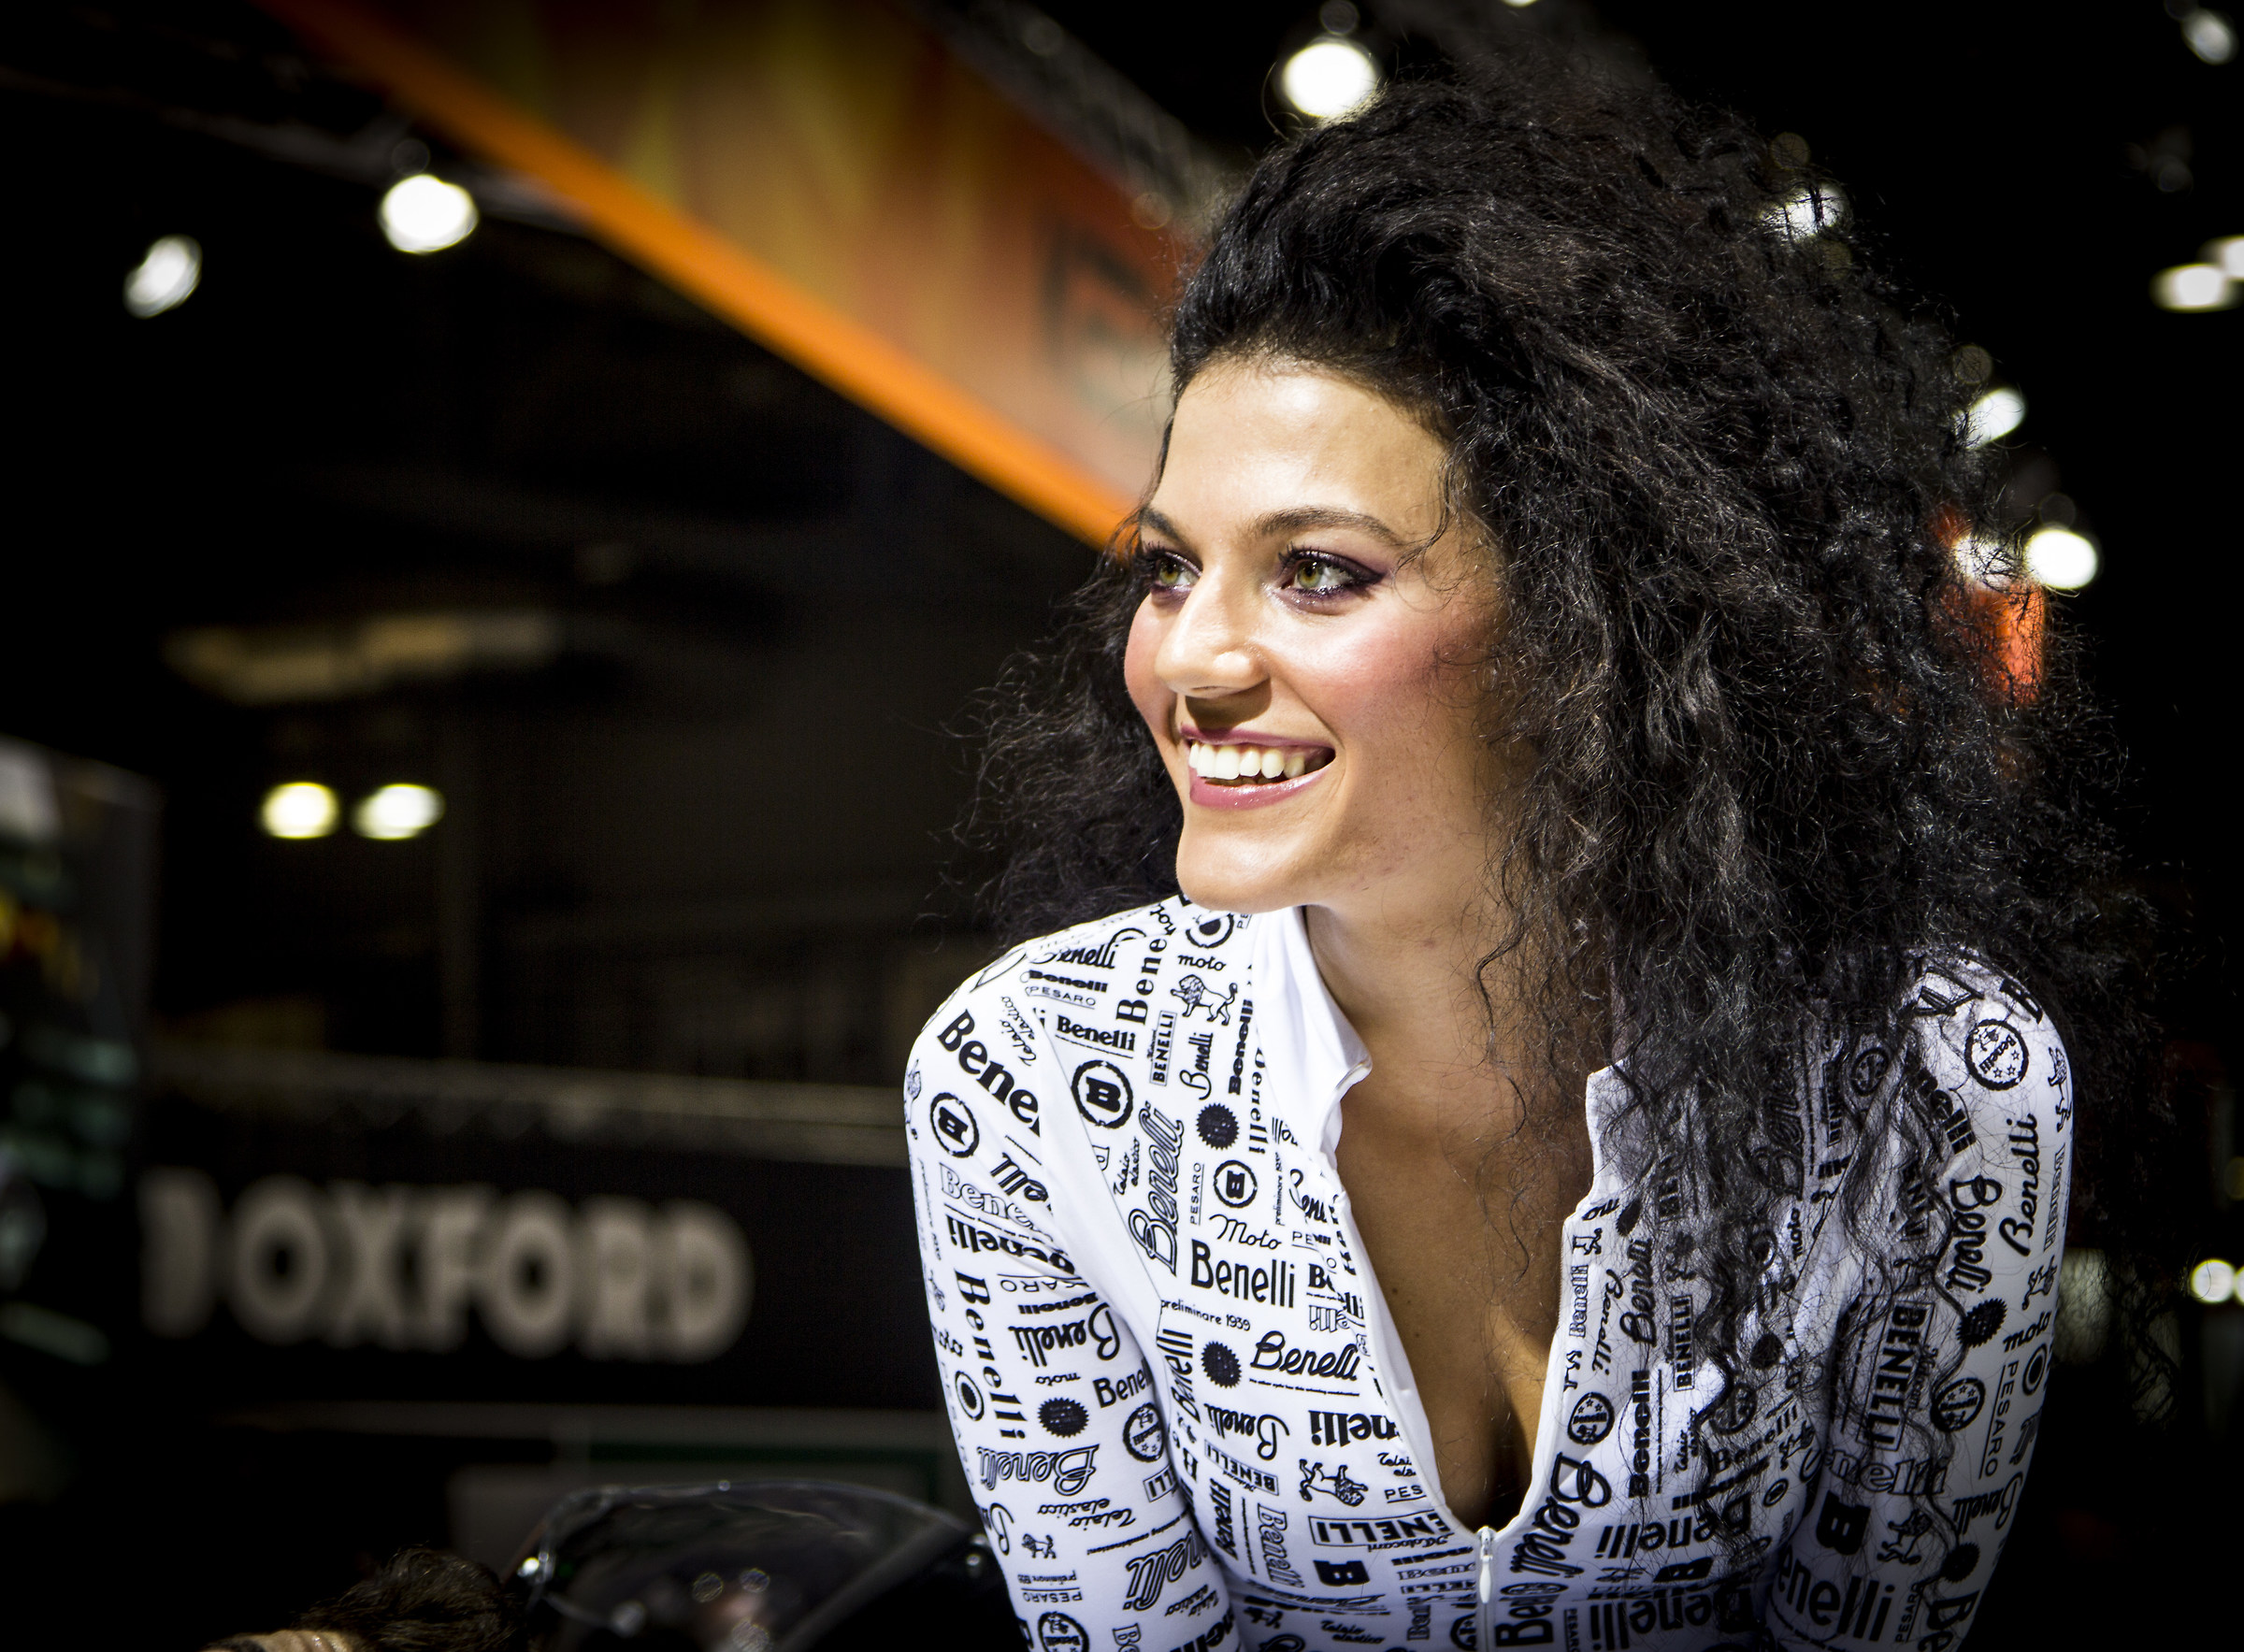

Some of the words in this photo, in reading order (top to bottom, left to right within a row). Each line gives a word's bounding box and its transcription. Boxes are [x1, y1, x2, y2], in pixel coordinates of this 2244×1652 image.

[1177, 955, 1226, 970] moto
[1057, 1014, 1136, 1052] Benelli
[1152, 1013, 1174, 1082] BENELLI
[1229, 999, 1254, 1095] Benelli
[1979, 1035, 2016, 1074] Benelli
[1086, 1077, 1120, 1113] B
[1179, 1032, 1214, 1100] Benelli
[1128, 1100, 1185, 1276] Benelli
[1189, 1162, 1202, 1225] PESARO
[1226, 1171, 1245, 1199] B
[1999, 1112, 2040, 1257] Benelli
[1209, 1214, 1282, 1250] Moto
[1946, 1174, 2004, 1294] Benelli
[229, 1178, 751, 1362] OXFORD
[1191, 1238, 1294, 1308] Benelli
[1569, 1265, 1589, 1339] Benelli
[1619, 1238, 1657, 1348] Benelli
[1008, 1302, 1120, 1368] Benelli
[1161, 1300, 1223, 1324] preliminare
[1226, 1314, 1251, 1331] 1939
[1592, 1269, 1623, 1375] Benelli
[1676, 1299, 1692, 1388] BENELLI
[2003, 1313, 2051, 1353] moto
[954, 1268, 1028, 1438] Benelli
[1035, 1372, 1082, 1387] moto
[1250, 1330, 1360, 1381] Benelli
[1866, 1306, 1927, 1445] BENELLI
[1203, 1403, 1290, 1461] Benelli
[1308, 1410, 1402, 1447] nelli
[1629, 1369, 1651, 1498] Benelli
[1983, 1359, 2019, 1478] PESARO
[976, 1443, 1100, 1496] Benelli
[1206, 1444, 1275, 1493] BENELLI
[1038, 1498, 1111, 1517] elastico
[1068, 1509, 1137, 1530] Telaio
[1510, 1452, 1613, 1578] Benelli
[1595, 1492, 1751, 1559] Benelli
[1816, 1490, 1871, 1555] B
[1952, 1472, 2024, 1534] Benelli
[1257, 1501, 1305, 1588] Benelli
[1313, 1559, 1370, 1587] B
[1023, 1591, 1083, 1603] PESARO
[1590, 1587, 1754, 1651] Benelli
[1895, 1583, 1919, 1644] PESARO
